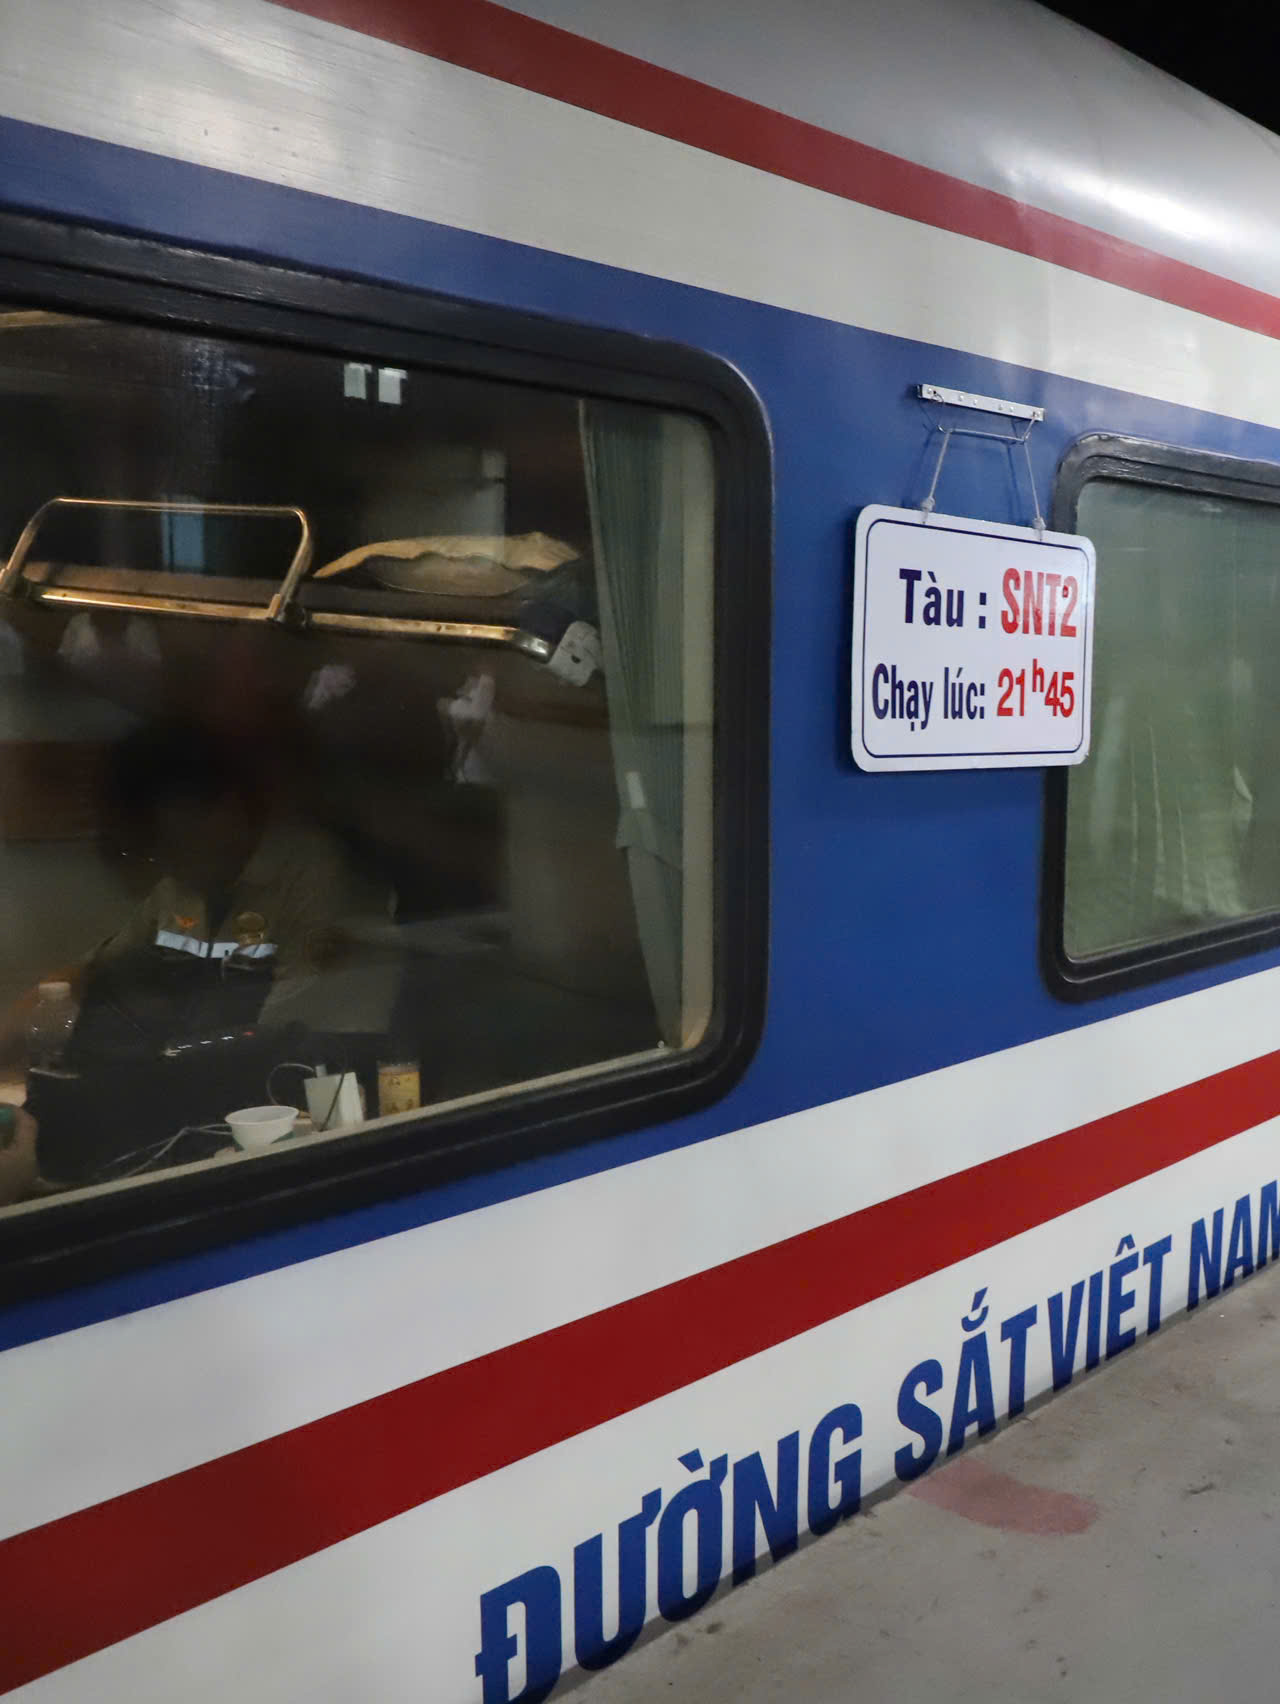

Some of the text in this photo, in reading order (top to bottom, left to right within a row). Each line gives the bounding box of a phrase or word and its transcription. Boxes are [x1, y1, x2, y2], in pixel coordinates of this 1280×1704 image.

[899, 568, 965, 627] Tàu
[1001, 567, 1078, 637] SNT2
[872, 658, 1075, 732] Chạy lúc: 21h45
[475, 1403, 863, 1704] ĐƯỜNG
[894, 1287, 1038, 1481] SẮT
